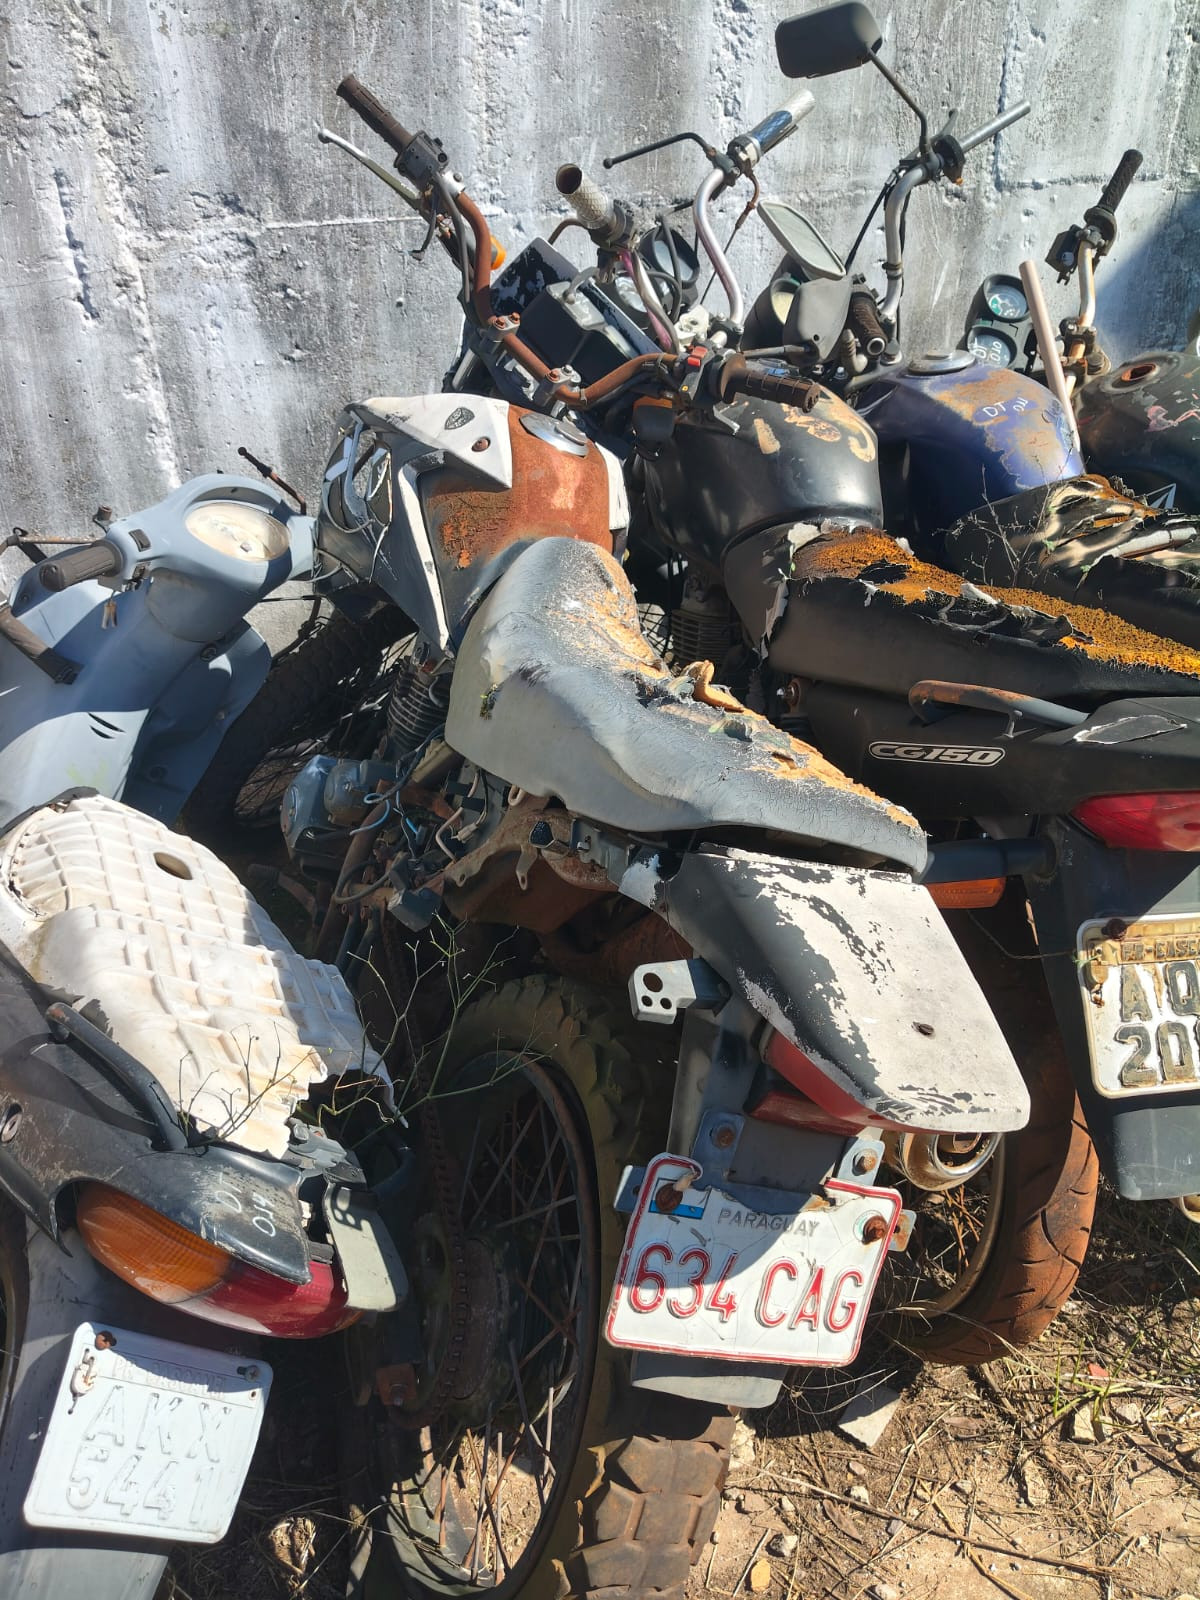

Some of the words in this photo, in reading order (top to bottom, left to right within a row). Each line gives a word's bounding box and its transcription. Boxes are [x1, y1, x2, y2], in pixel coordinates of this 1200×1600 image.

[983, 401, 1006, 417] DT
[1114, 1020, 1200, 1087] 20
[718, 1207, 821, 1238] PARAGUAY
[629, 1242, 740, 1322] 634
[754, 1256, 864, 1333] CAG
[83, 1384, 232, 1463] AKX
[66, 1446, 216, 1525] 5441
